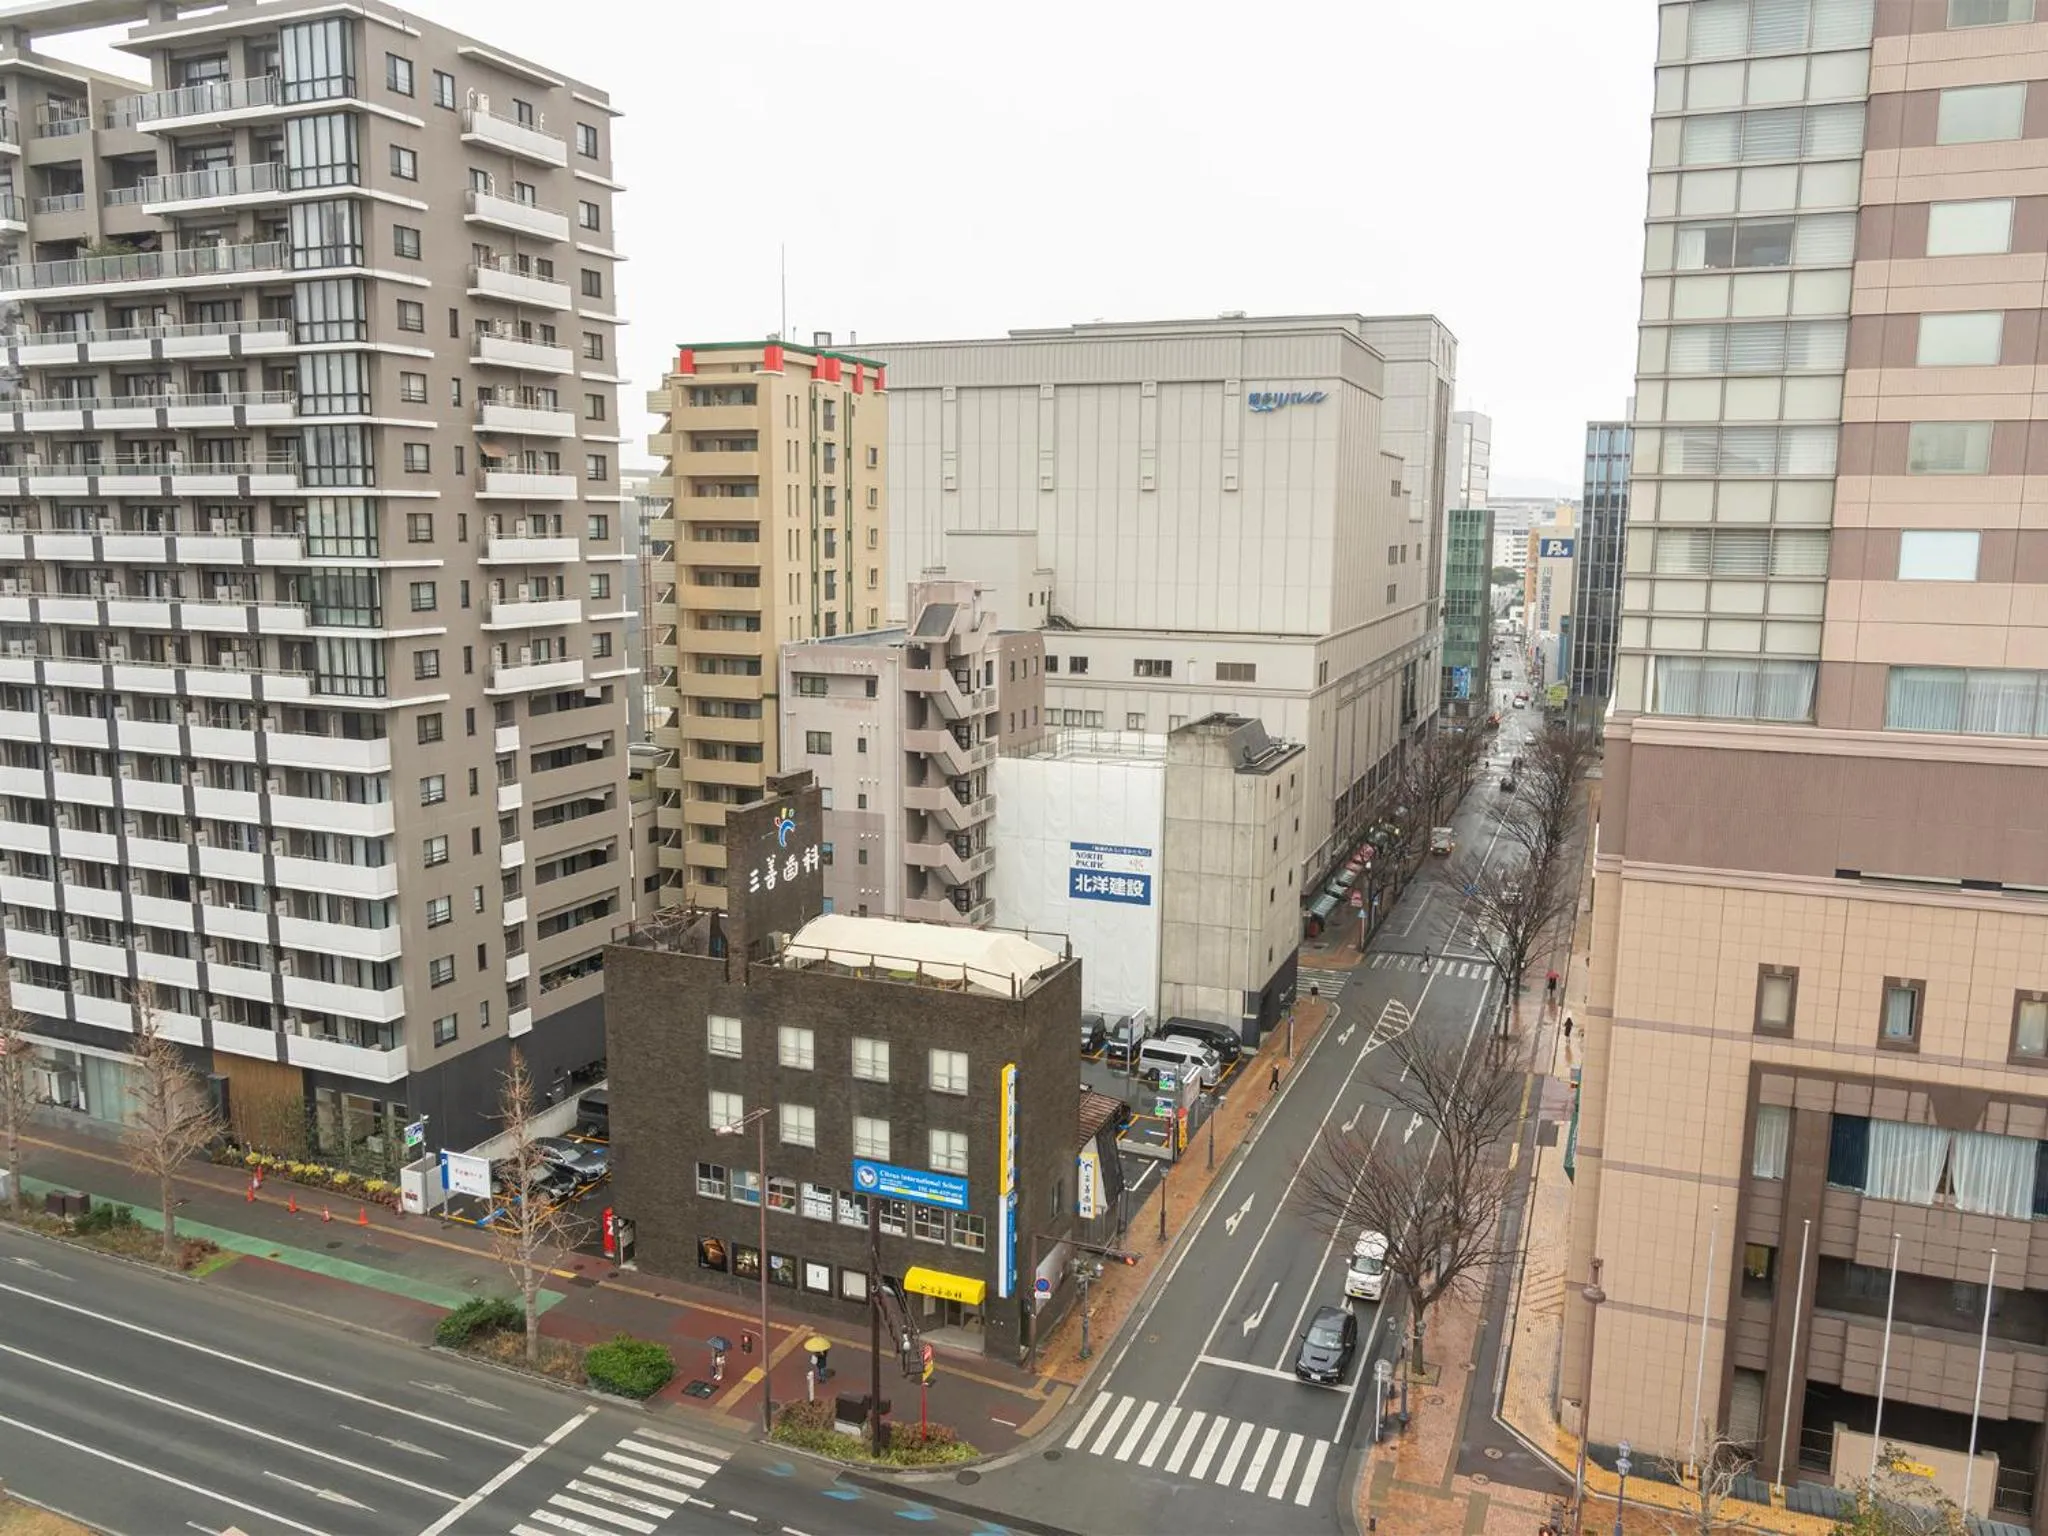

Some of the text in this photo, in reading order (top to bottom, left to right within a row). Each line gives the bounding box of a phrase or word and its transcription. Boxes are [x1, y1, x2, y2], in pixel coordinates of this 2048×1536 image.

[1075, 852, 1103, 861] NORTH
[1075, 860, 1104, 869] PACIFIC
[1075, 873, 1145, 898] 北洋建設
[900, 1173, 940, 1187] International
